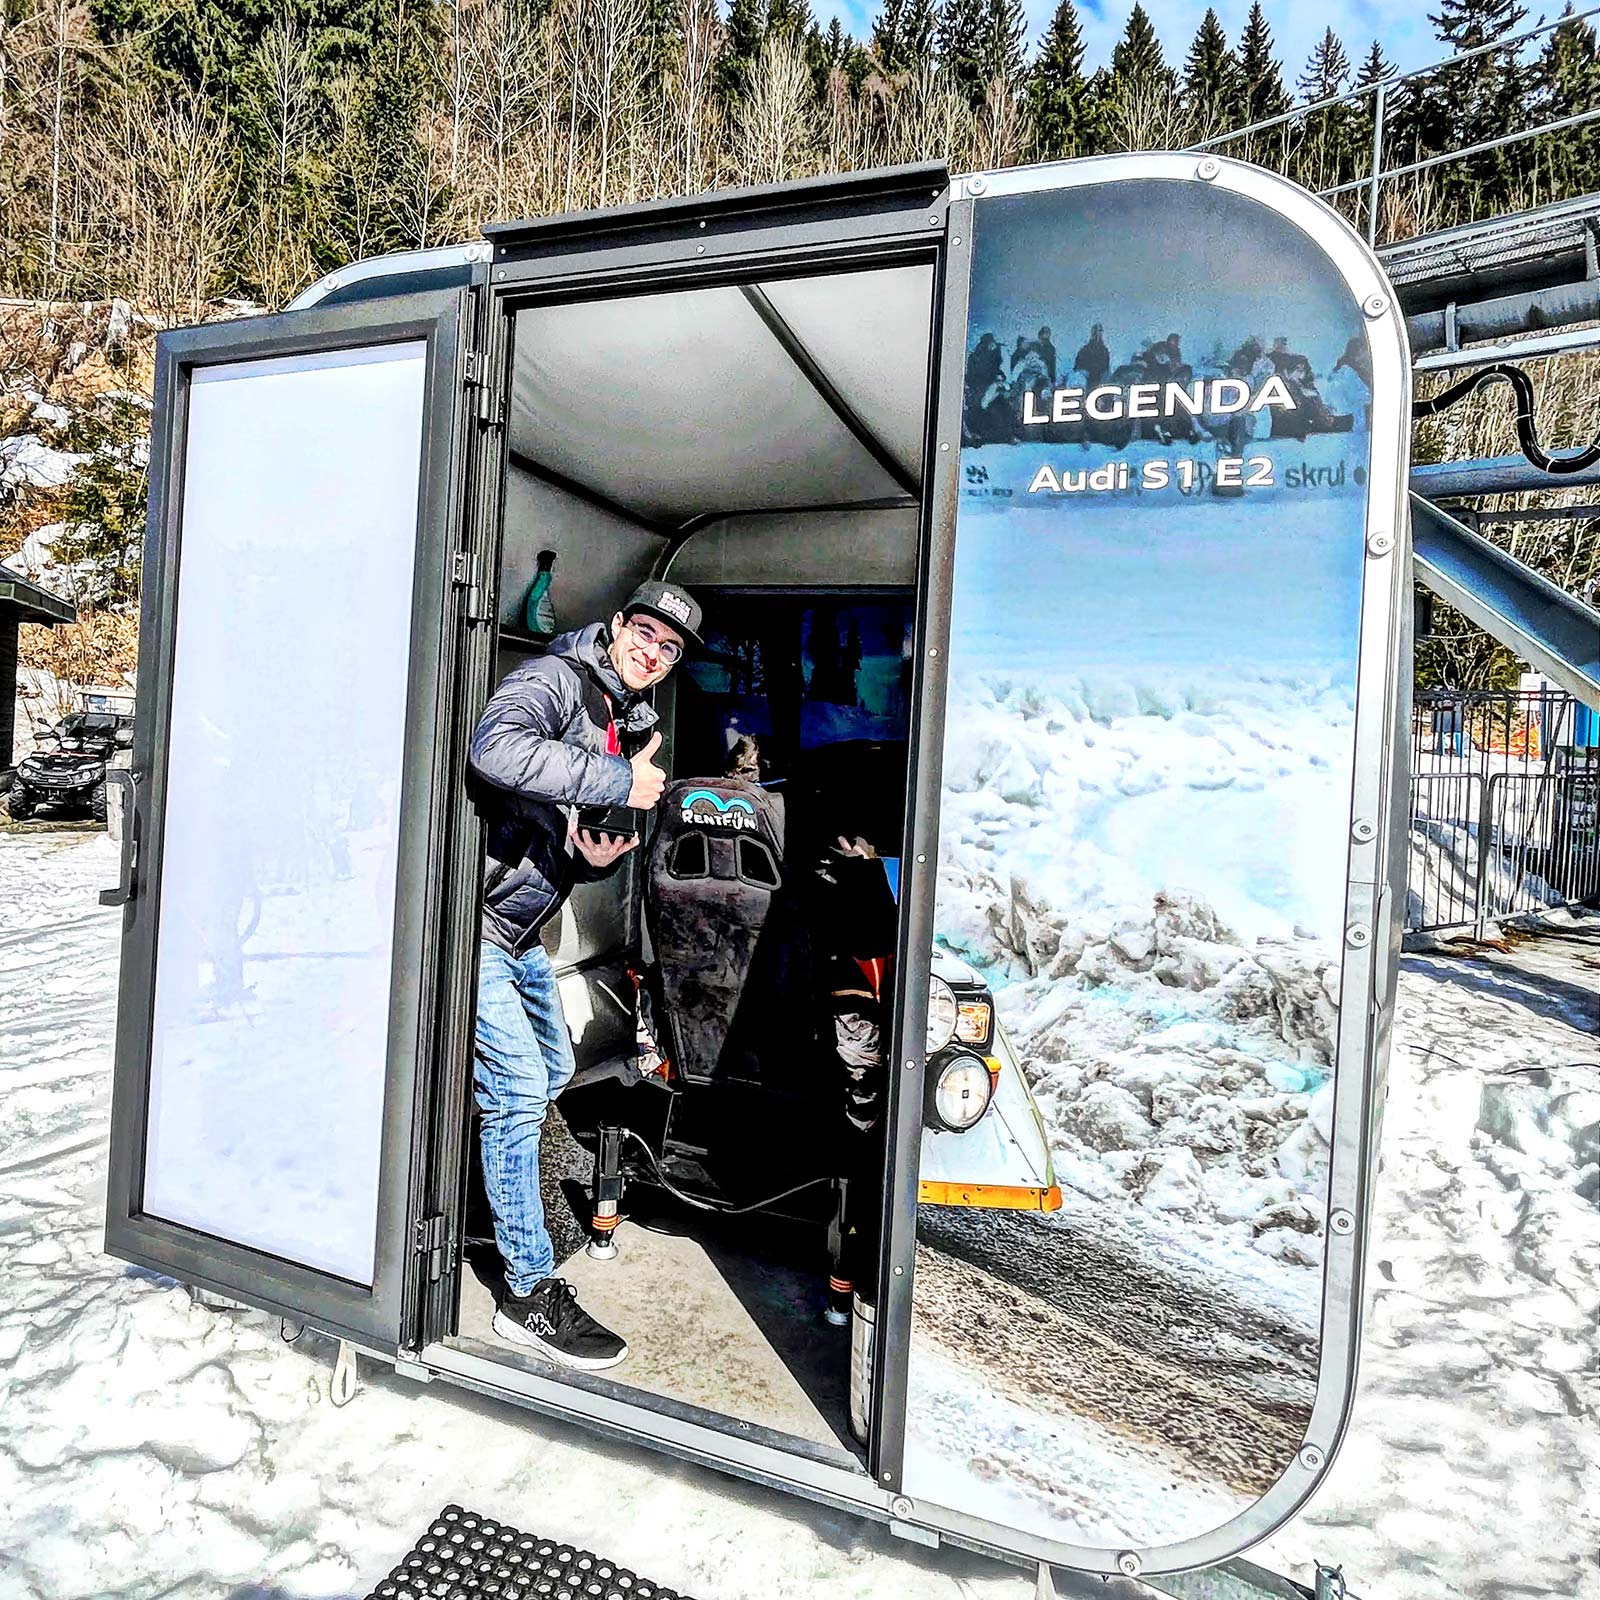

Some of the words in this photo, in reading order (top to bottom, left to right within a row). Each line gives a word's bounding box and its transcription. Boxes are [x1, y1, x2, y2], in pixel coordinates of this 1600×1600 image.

[1022, 375, 1297, 425] LEGENDA
[1027, 462, 1129, 493] Audi
[1216, 456, 1274, 486] E2
